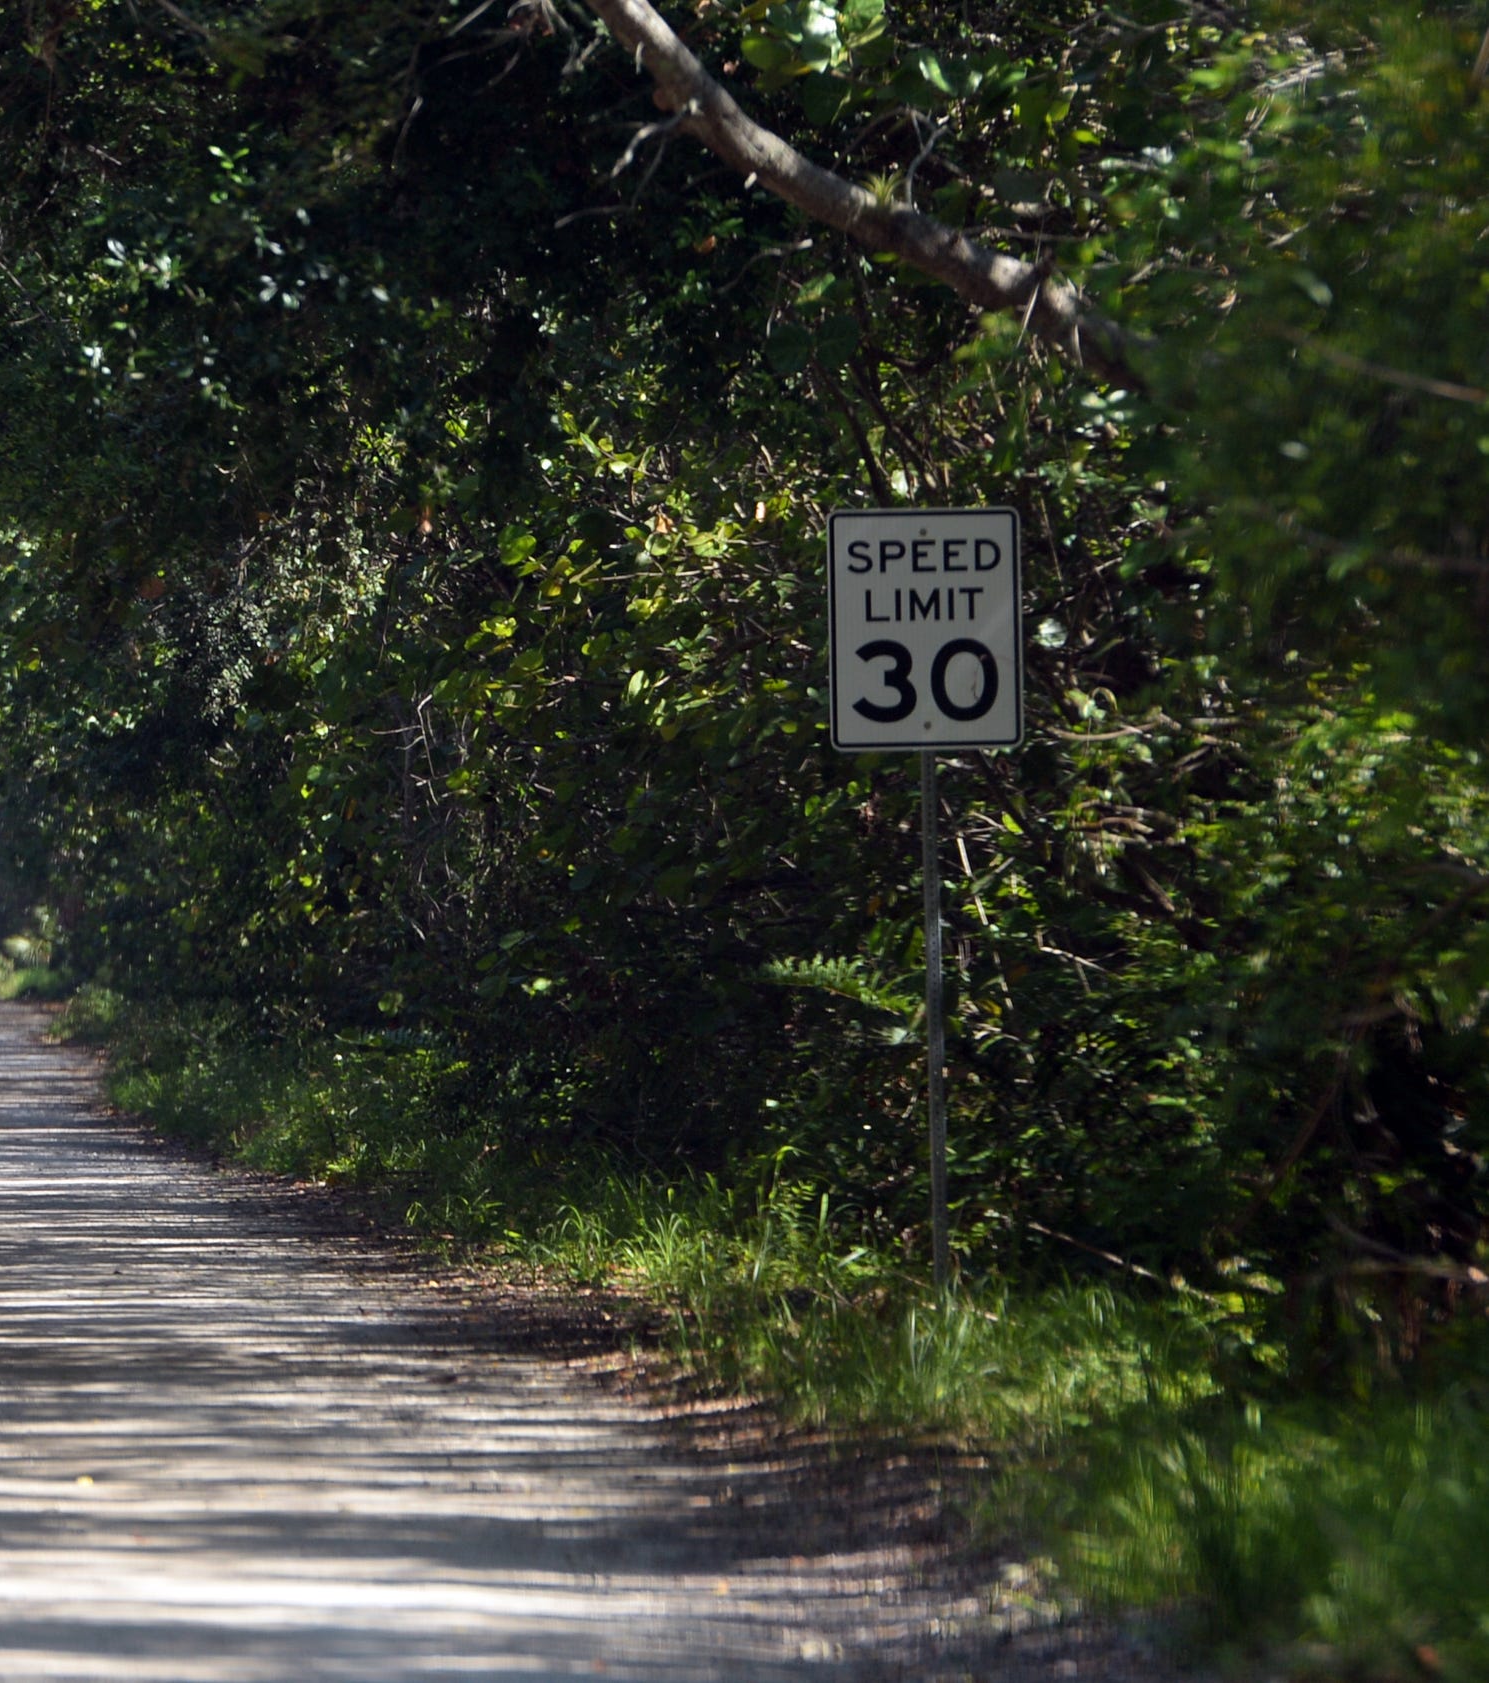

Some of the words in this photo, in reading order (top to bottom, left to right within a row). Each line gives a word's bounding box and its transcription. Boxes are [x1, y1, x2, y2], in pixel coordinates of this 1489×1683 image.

[847, 538, 1001, 574] SPEED
[865, 587, 984, 622] LIMIT
[852, 637, 999, 723] 30
